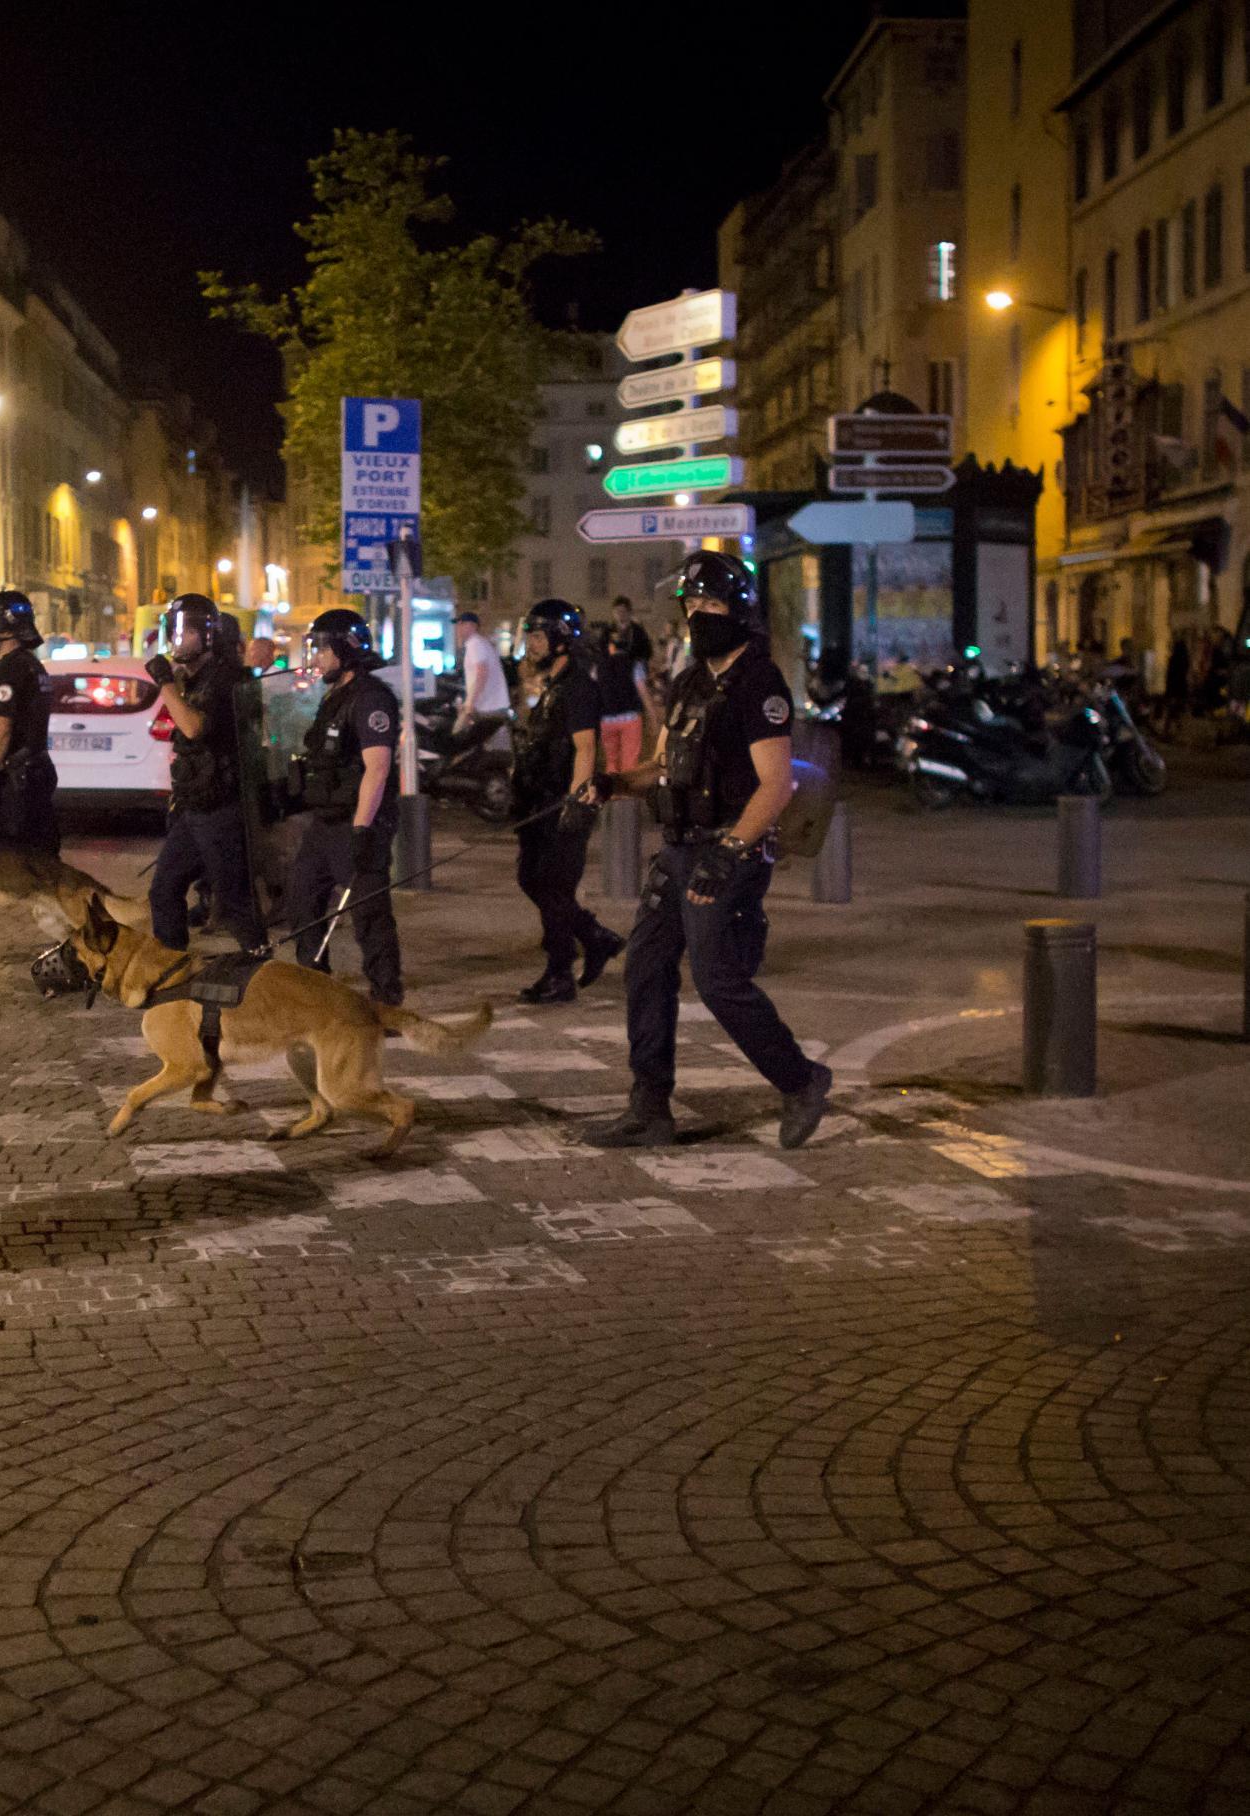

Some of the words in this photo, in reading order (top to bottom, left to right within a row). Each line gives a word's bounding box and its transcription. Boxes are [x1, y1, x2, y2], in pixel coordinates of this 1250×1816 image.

[363, 403, 400, 448] P
[352, 455, 411, 468] VIEUX
[356, 469, 407, 483] PORT
[352, 485, 411, 498] ESTIENNE
